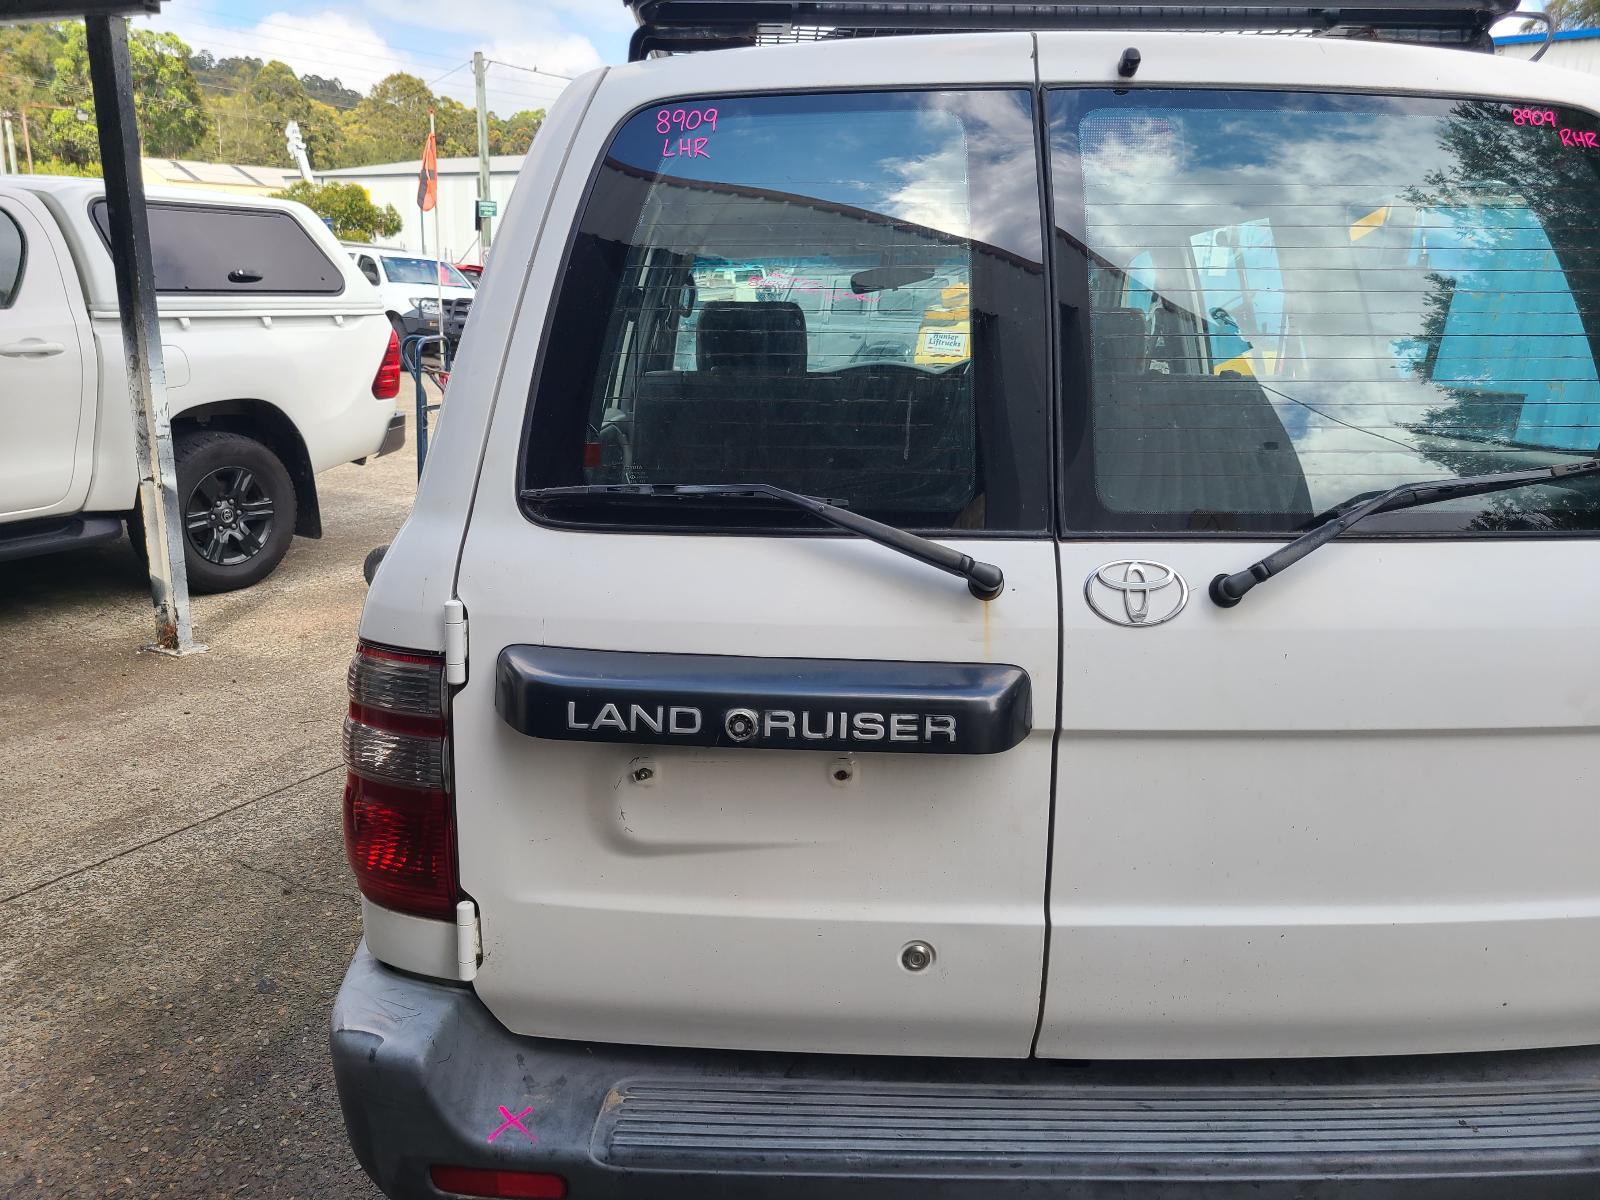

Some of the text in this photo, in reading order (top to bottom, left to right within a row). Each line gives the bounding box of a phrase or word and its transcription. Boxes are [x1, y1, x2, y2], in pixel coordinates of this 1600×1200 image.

[656, 108, 719, 134] 8909
[1512, 108, 1556, 128] 8909
[662, 137, 712, 159] LHR
[1559, 128, 1600, 148] RHR
[567, 701, 702, 734] LAND
